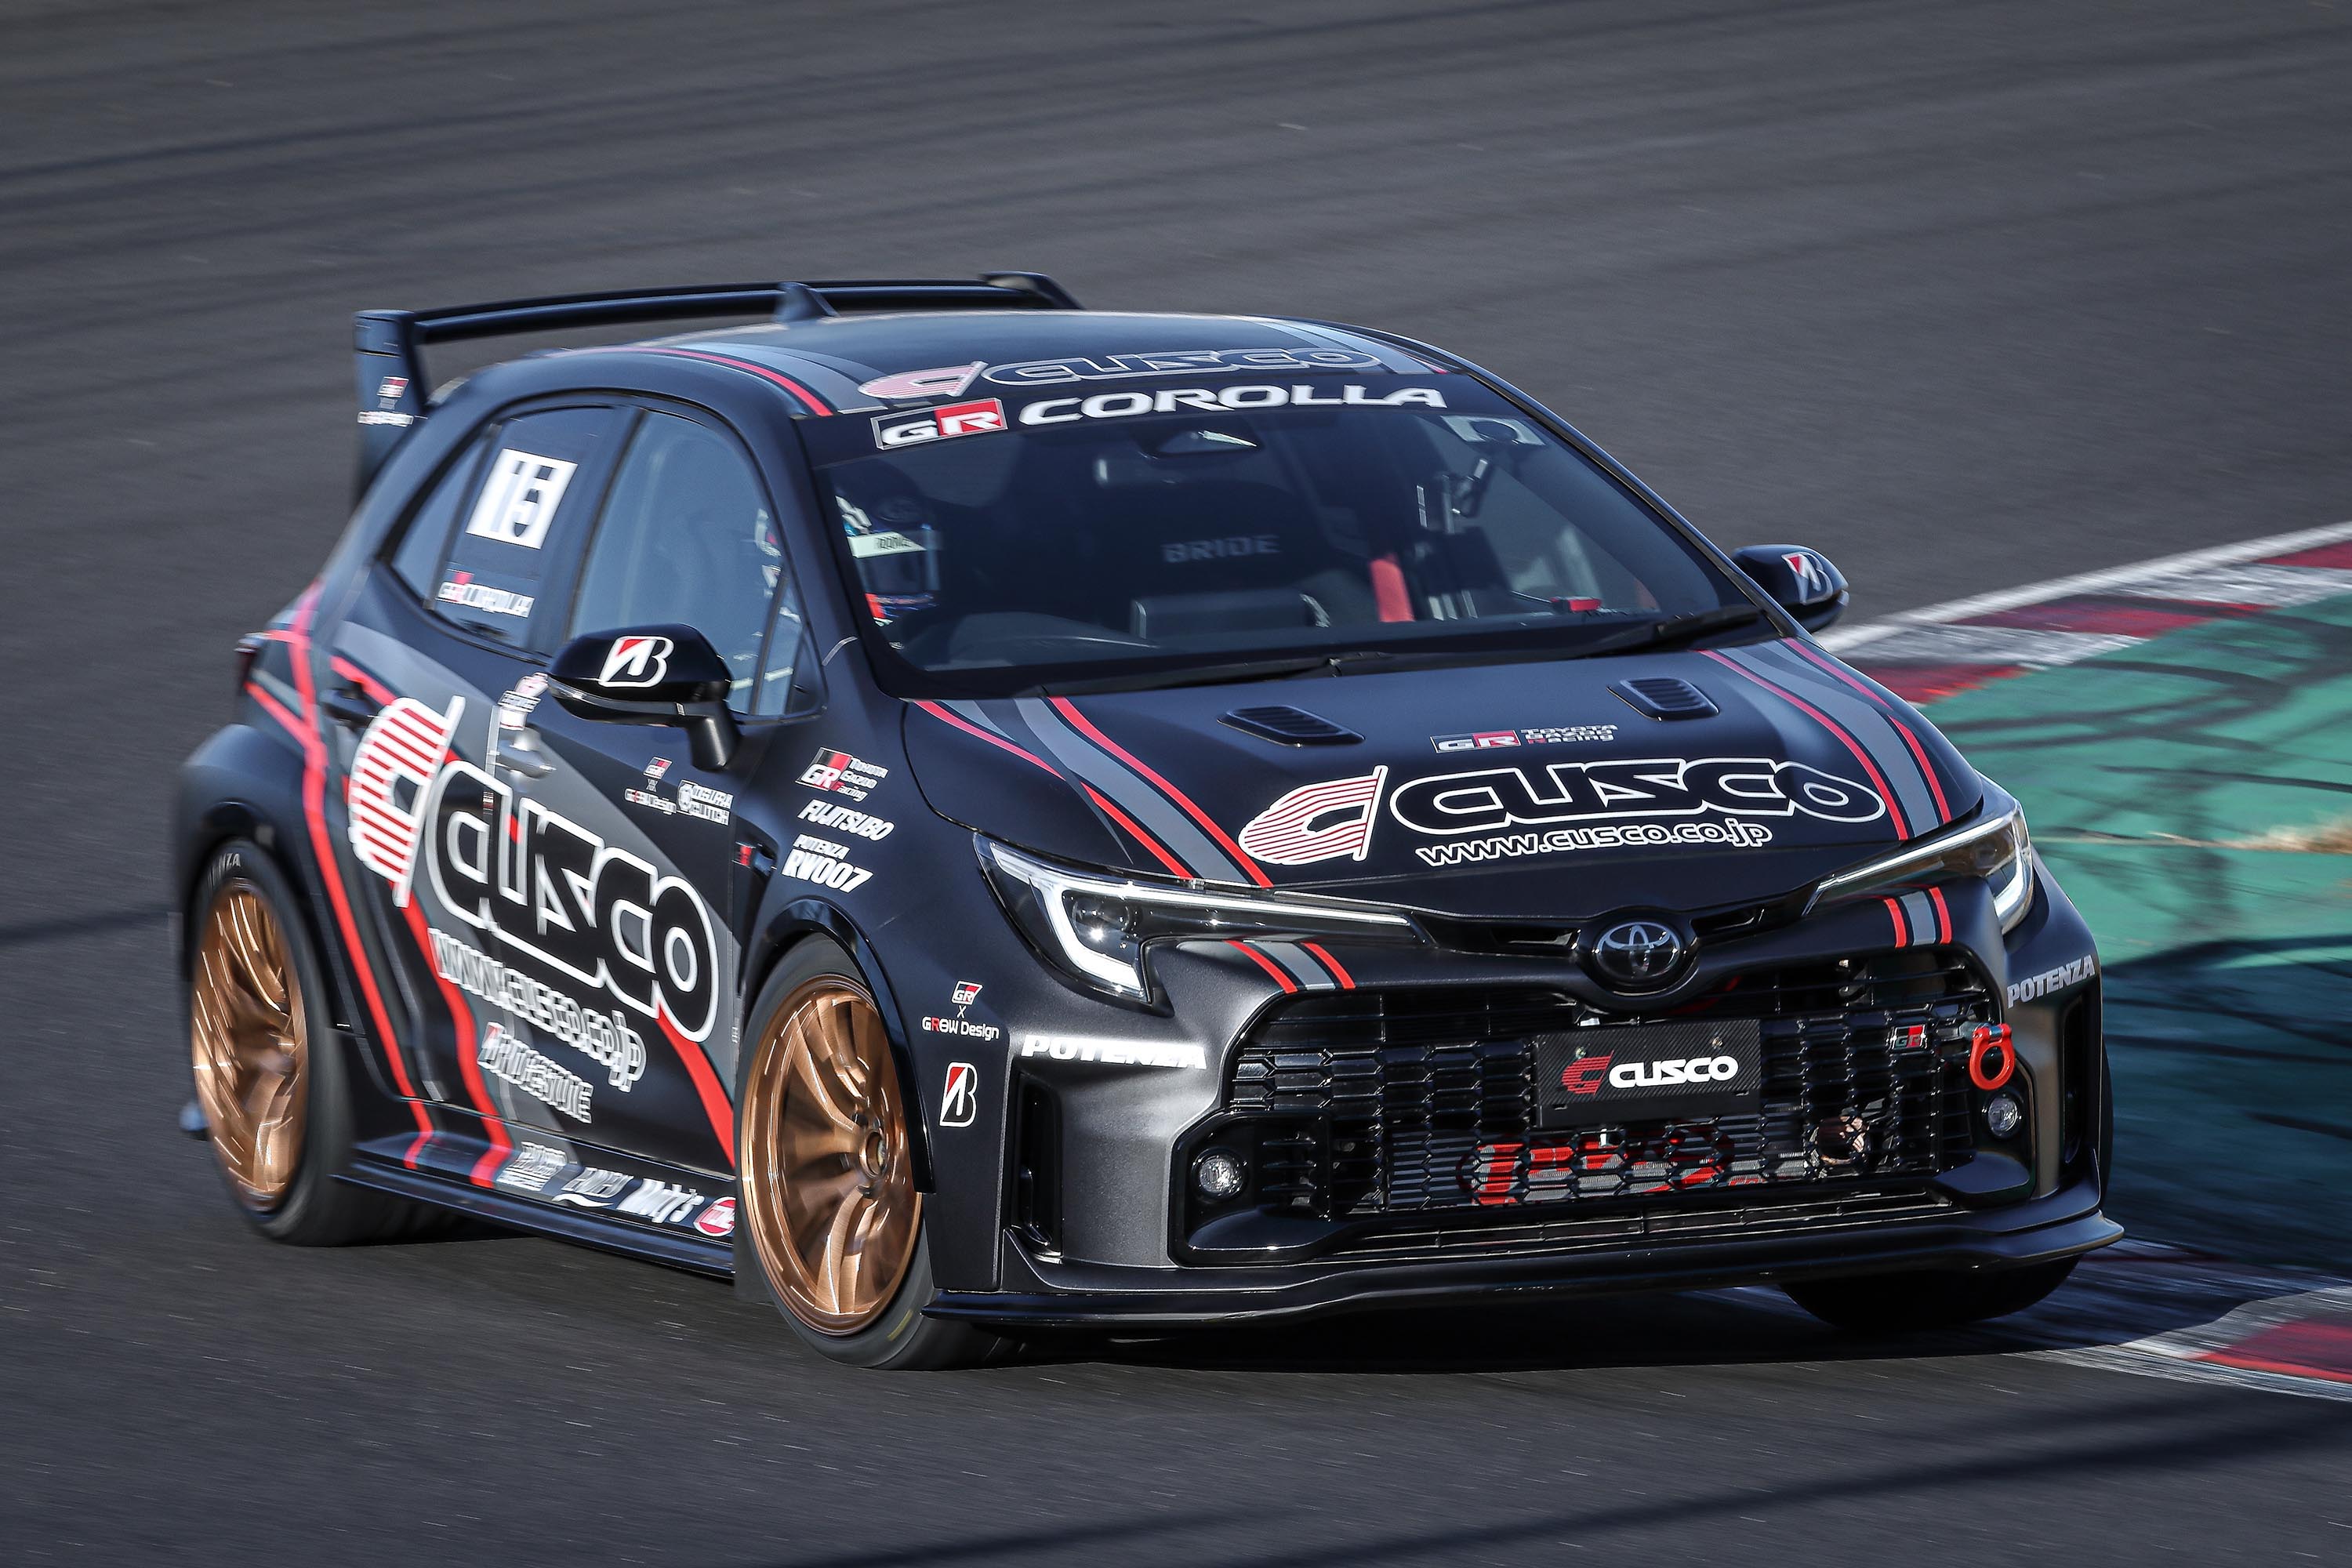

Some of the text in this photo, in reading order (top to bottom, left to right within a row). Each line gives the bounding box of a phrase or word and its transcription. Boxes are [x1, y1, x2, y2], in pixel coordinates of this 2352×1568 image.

[982, 348, 1382, 386] CUSCO
[880, 384, 1448, 445] GR COROLLA
[1161, 535, 1281, 563] BRIDE
[1438, 736, 1517, 751] GR
[800, 763, 842, 789] GR
[1390, 757, 1886, 835] CUSCO
[797, 799, 895, 841] FUJITSUBO
[1416, 818, 1773, 866] www.cusco.co.jp
[781, 848, 874, 894] RW007
[2006, 954, 2096, 1009] POTENZA
[960, 1021, 1000, 1041] Design
[1021, 1034, 1207, 1070] POTENZA
[1609, 1055, 1739, 1089] CUSCO
